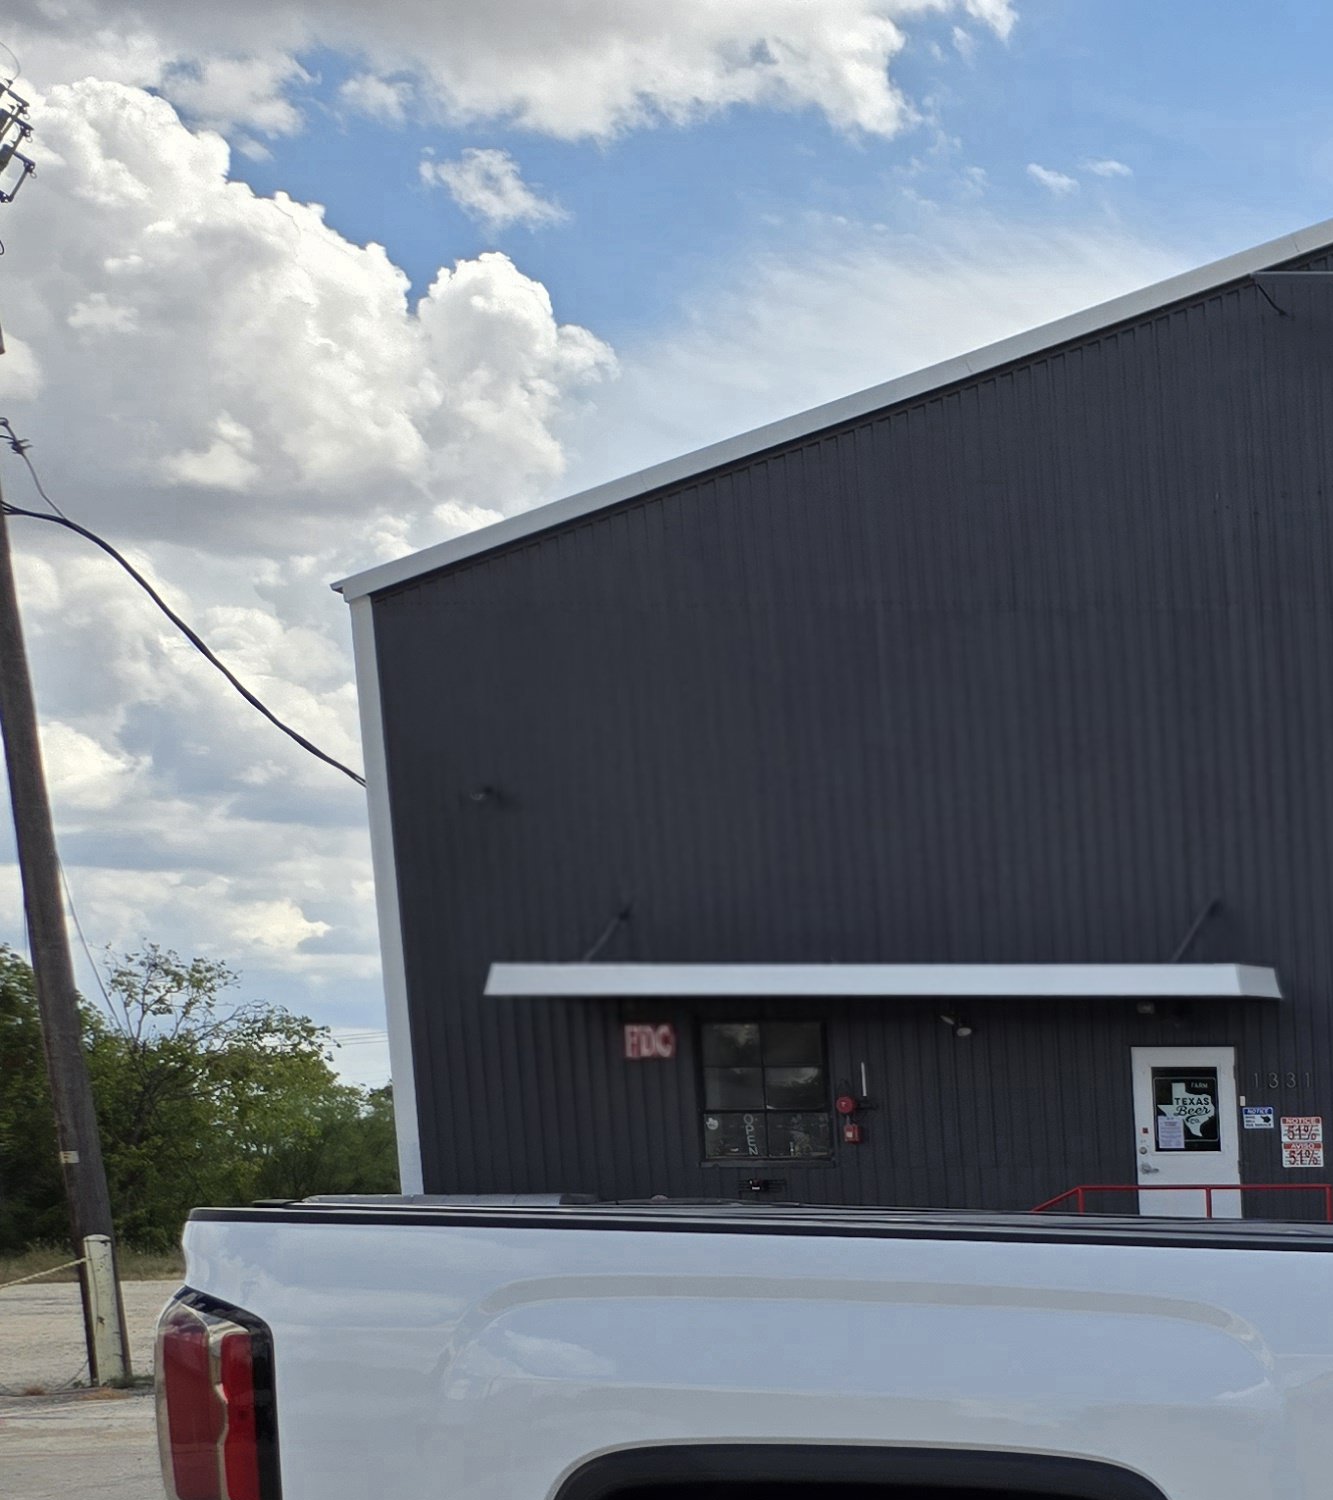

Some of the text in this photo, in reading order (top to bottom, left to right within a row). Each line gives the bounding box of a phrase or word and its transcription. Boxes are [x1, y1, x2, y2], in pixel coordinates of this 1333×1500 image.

[624, 1024, 673, 1058] FDC
[1253, 1072, 1312, 1088] 1331
[1174, 1097, 1210, 1106] TEXAS
[1173, 1105, 1211, 1117] Beer
